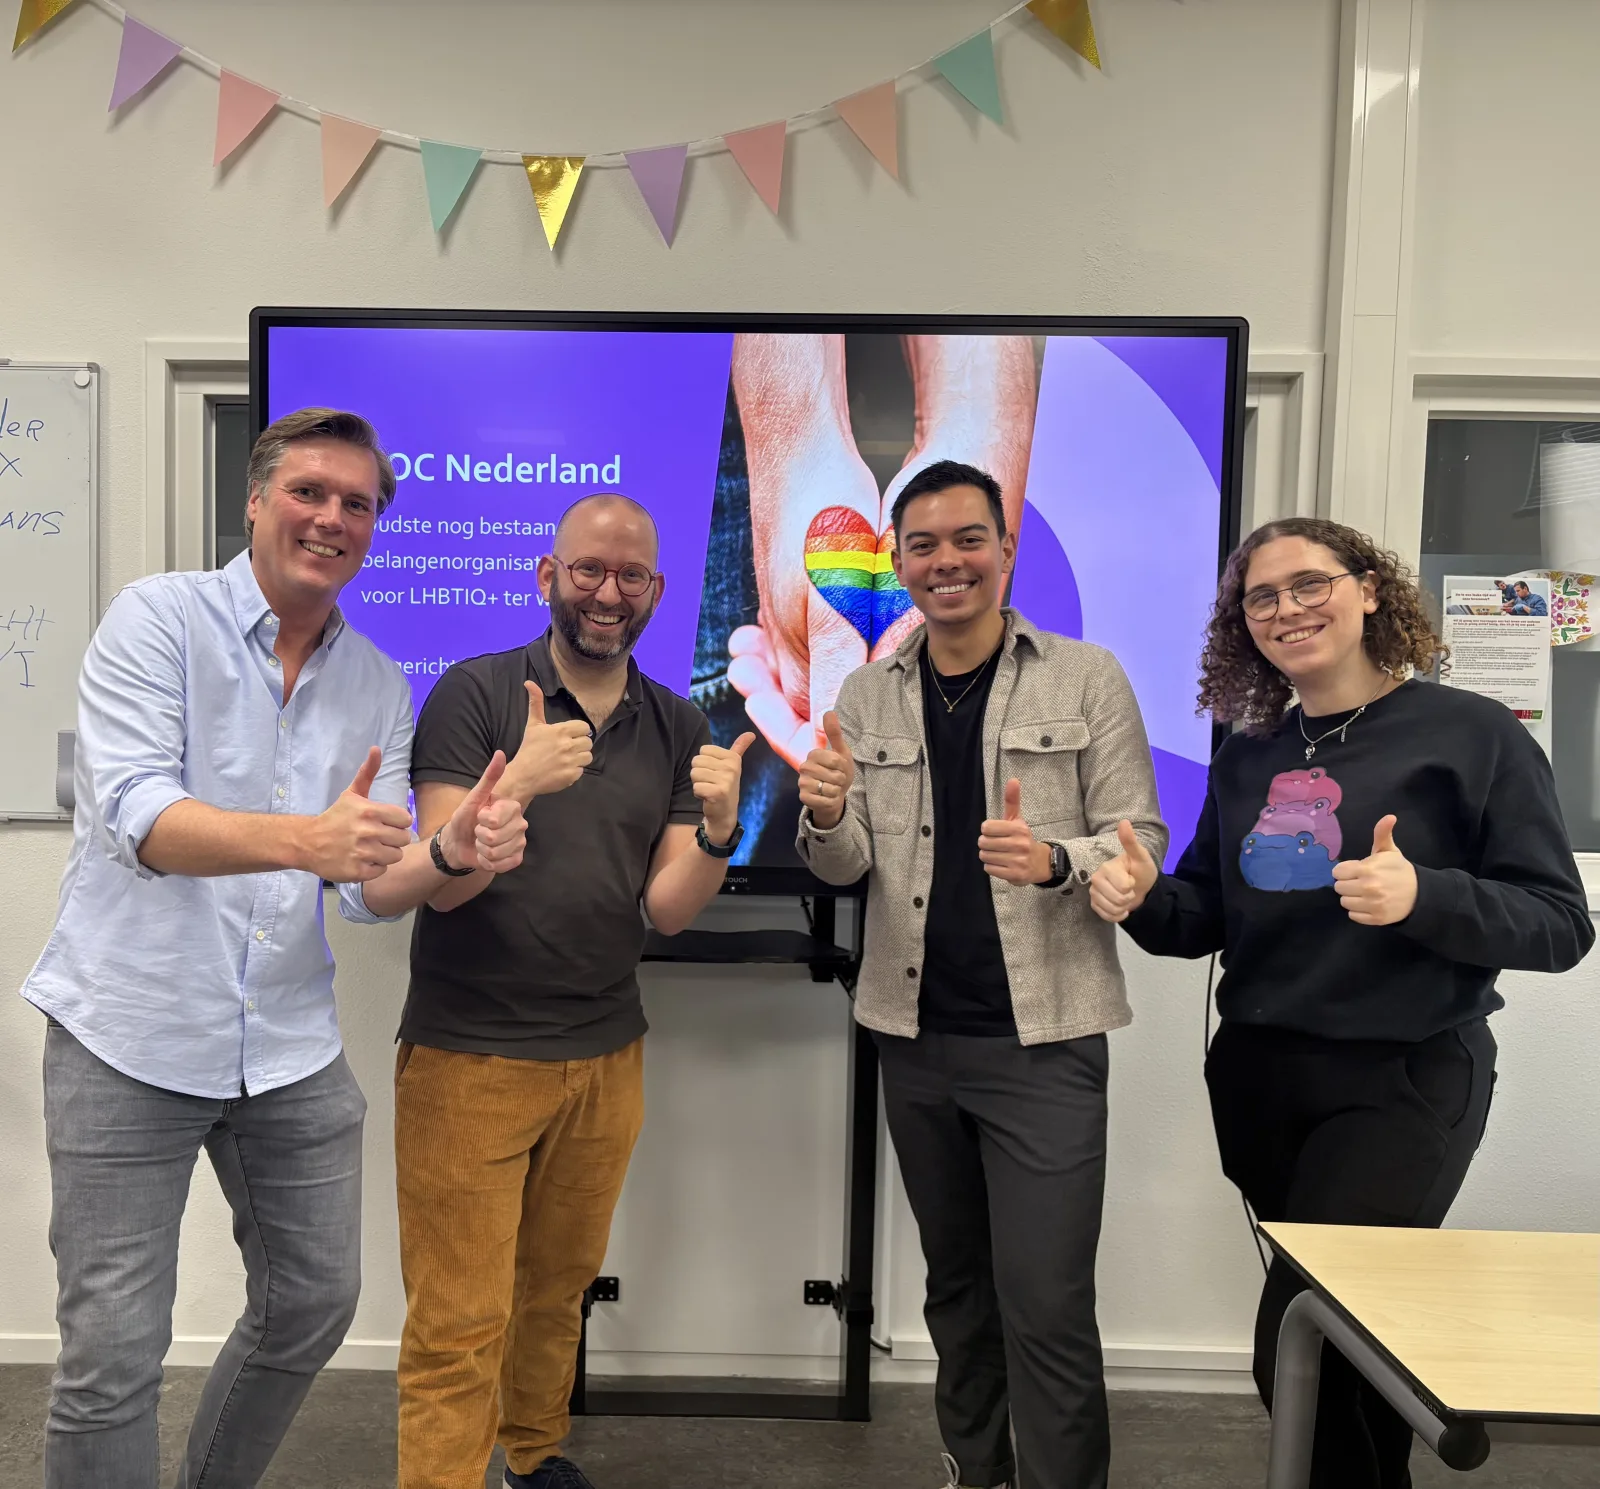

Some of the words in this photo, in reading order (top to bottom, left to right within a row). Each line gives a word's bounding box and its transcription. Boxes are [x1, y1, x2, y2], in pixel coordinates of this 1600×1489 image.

[446, 453, 621, 484] Nederland
[374, 514, 432, 534] udste
[437, 520, 474, 540] nog
[480, 516, 556, 536] bestaan
[361, 590, 405, 604] voor
[410, 587, 499, 606] LHBTIQ+
[503, 590, 532, 606] ter
[395, 656, 456, 675] erich
